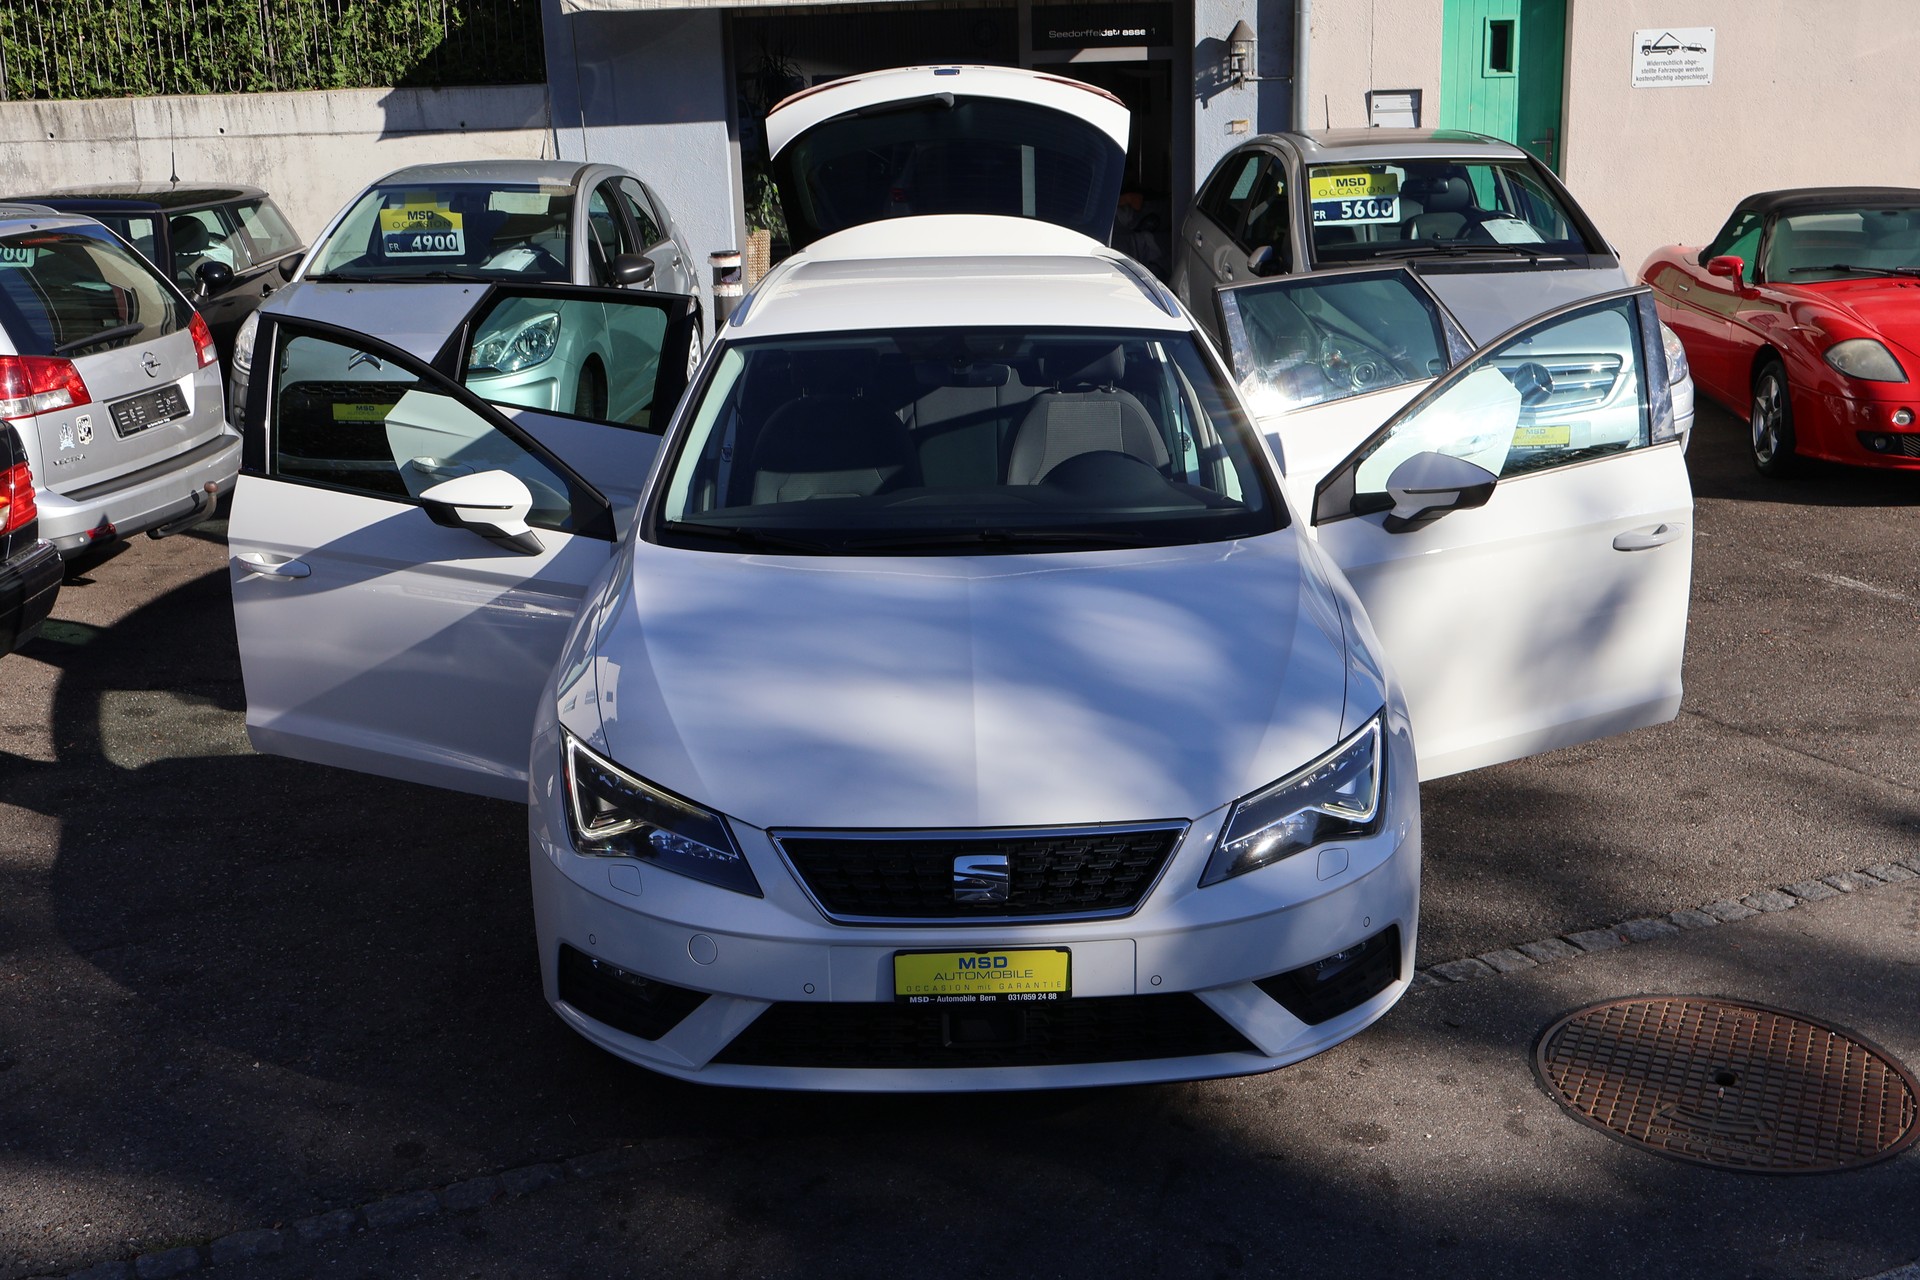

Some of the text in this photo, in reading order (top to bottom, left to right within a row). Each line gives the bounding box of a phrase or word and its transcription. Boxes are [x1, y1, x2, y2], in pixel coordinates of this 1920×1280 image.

[1150, 27, 1156, 36] 1
[1336, 177, 1367, 188] MSD
[1318, 186, 1386, 197] OCCASION
[407, 210, 434, 221] MSD
[1313, 200, 1393, 220] FR 5600
[392, 220, 451, 230] OCCASION
[388, 234, 457, 252] FR 4900
[958, 956, 1008, 970] MSD
[934, 969, 1034, 981] AUTOMOBILE
[906, 984, 970, 993] OCCASION
[998, 981, 1062, 990] GARANTIE
[979, 994, 996, 1002] Bern
[1007, 993, 1037, 1001] 031/859
[1037, 992, 1047, 1000] 24
[1047, 992, 1058, 1000] 88
